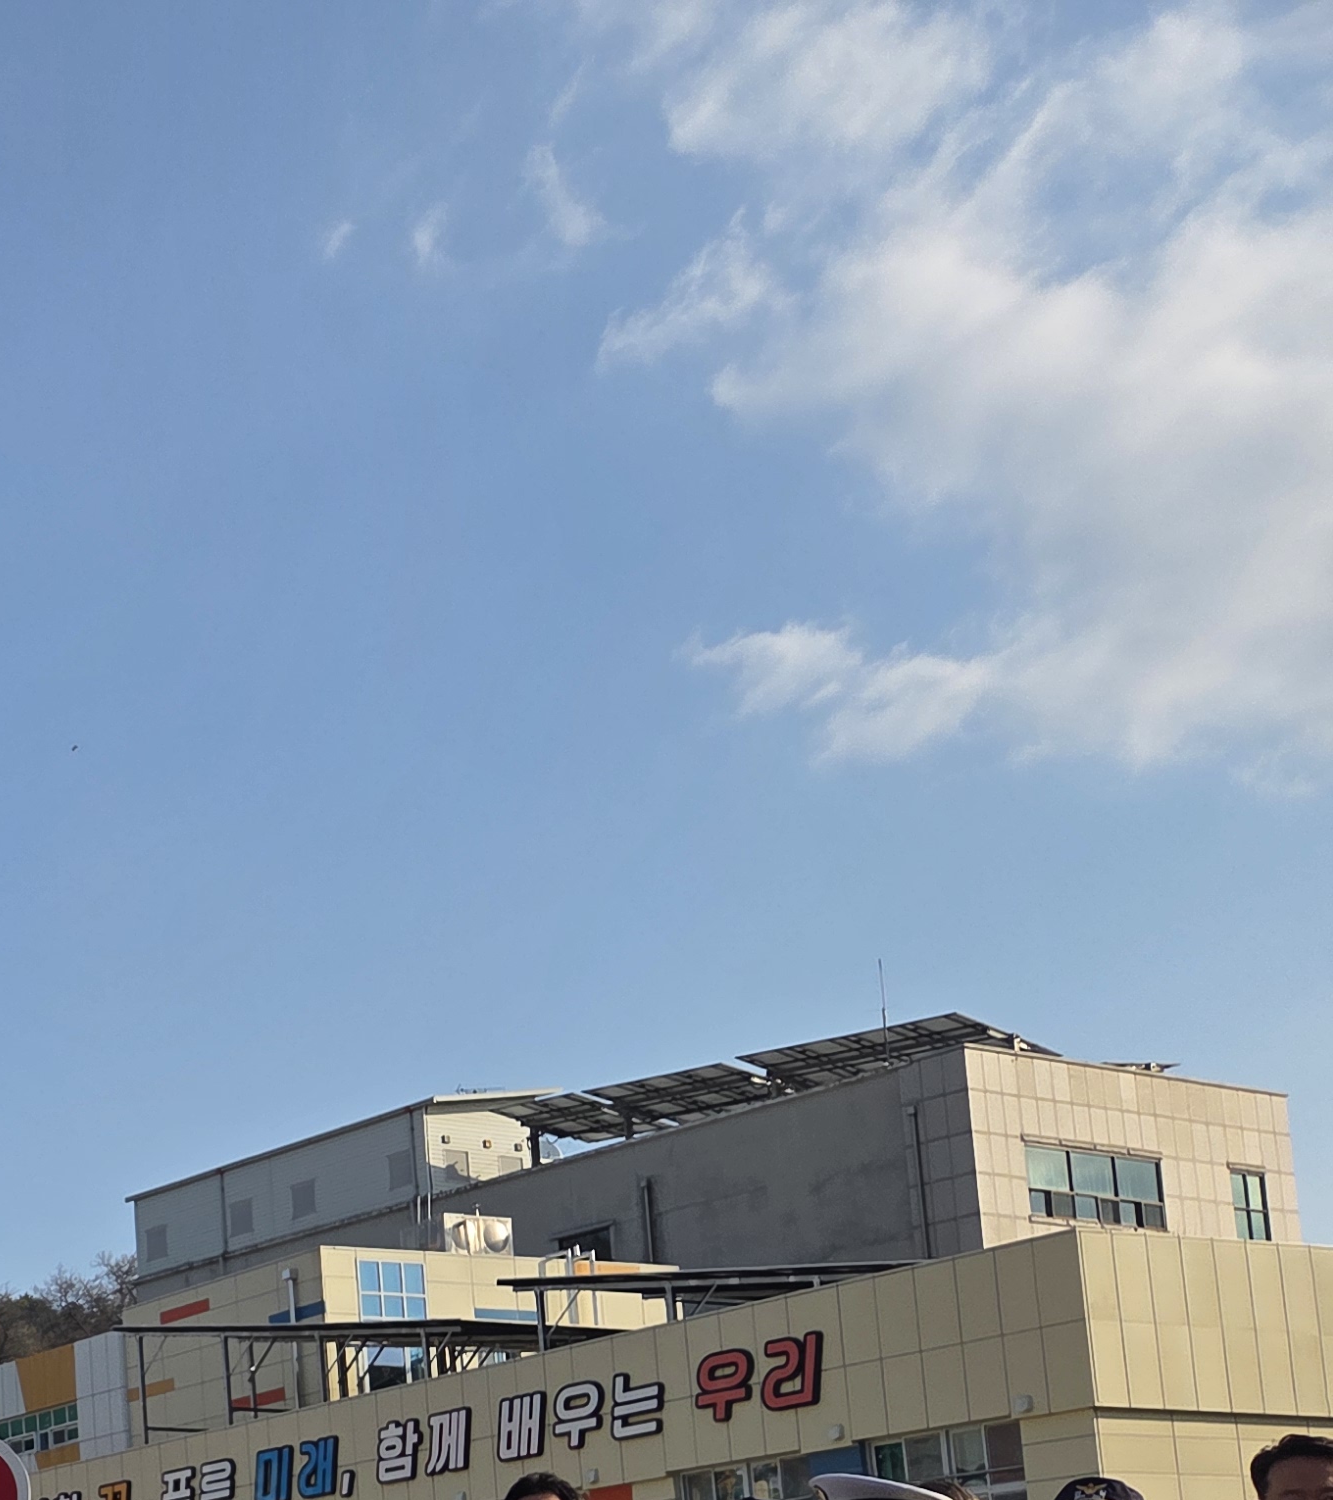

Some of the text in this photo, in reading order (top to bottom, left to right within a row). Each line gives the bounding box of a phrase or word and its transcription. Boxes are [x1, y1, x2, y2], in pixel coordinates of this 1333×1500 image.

[377, 1406, 470, 1483] 함께
[497, 1372, 664, 1462] 배우는
[695, 1330, 824, 1422] 우리
